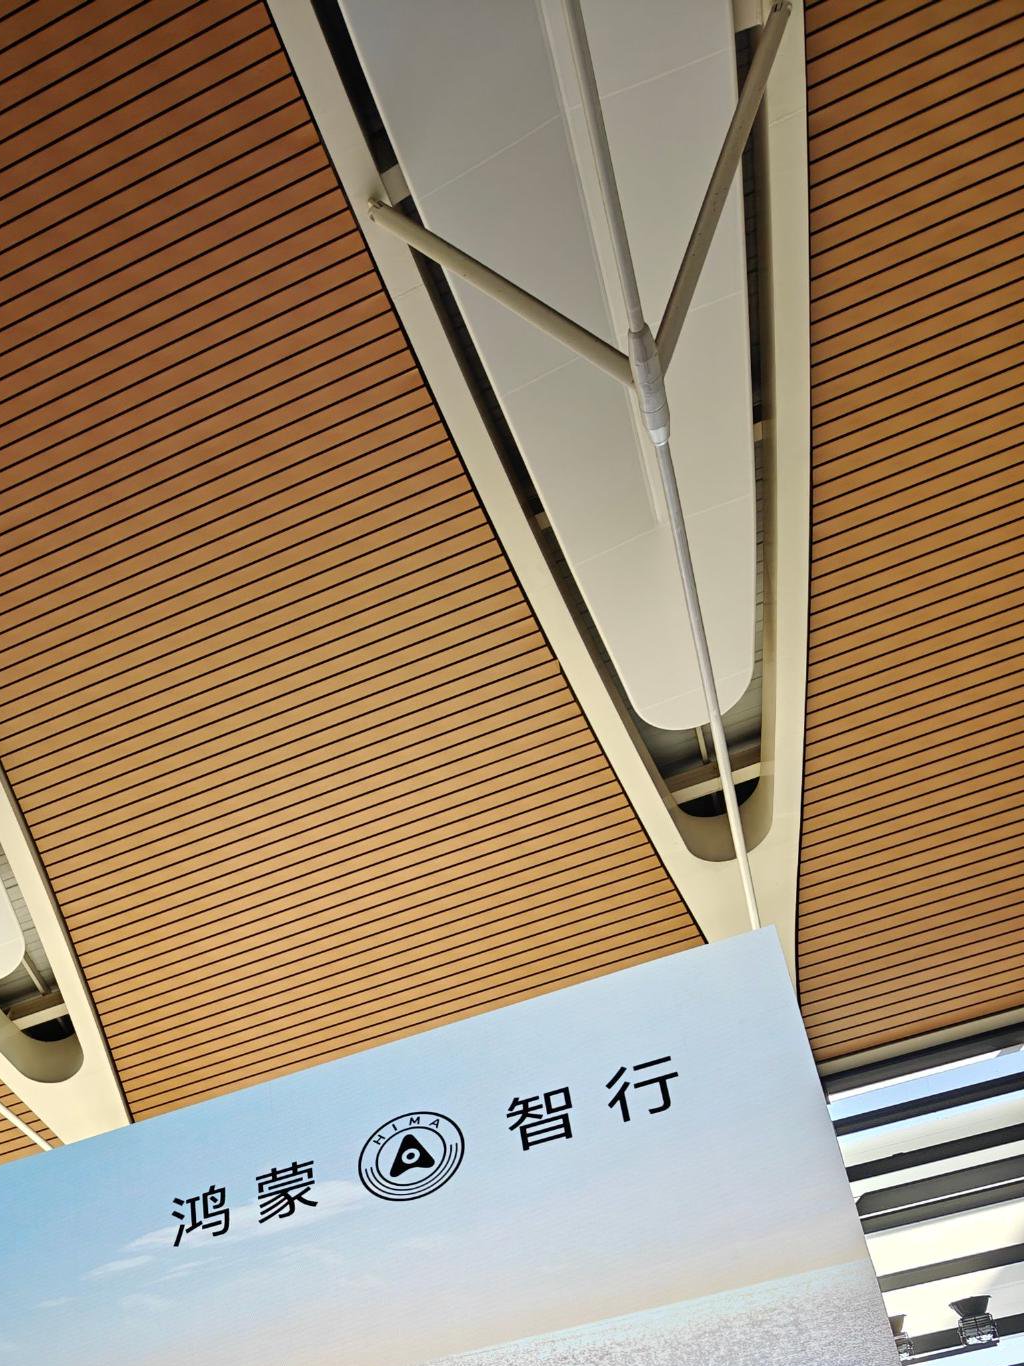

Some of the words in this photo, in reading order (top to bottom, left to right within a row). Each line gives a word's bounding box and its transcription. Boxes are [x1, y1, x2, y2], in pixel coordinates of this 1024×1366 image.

[170, 1160, 319, 1248] 鸿蒙
[505, 1055, 679, 1151] 智行
[373, 1116, 440, 1145] HIMA
